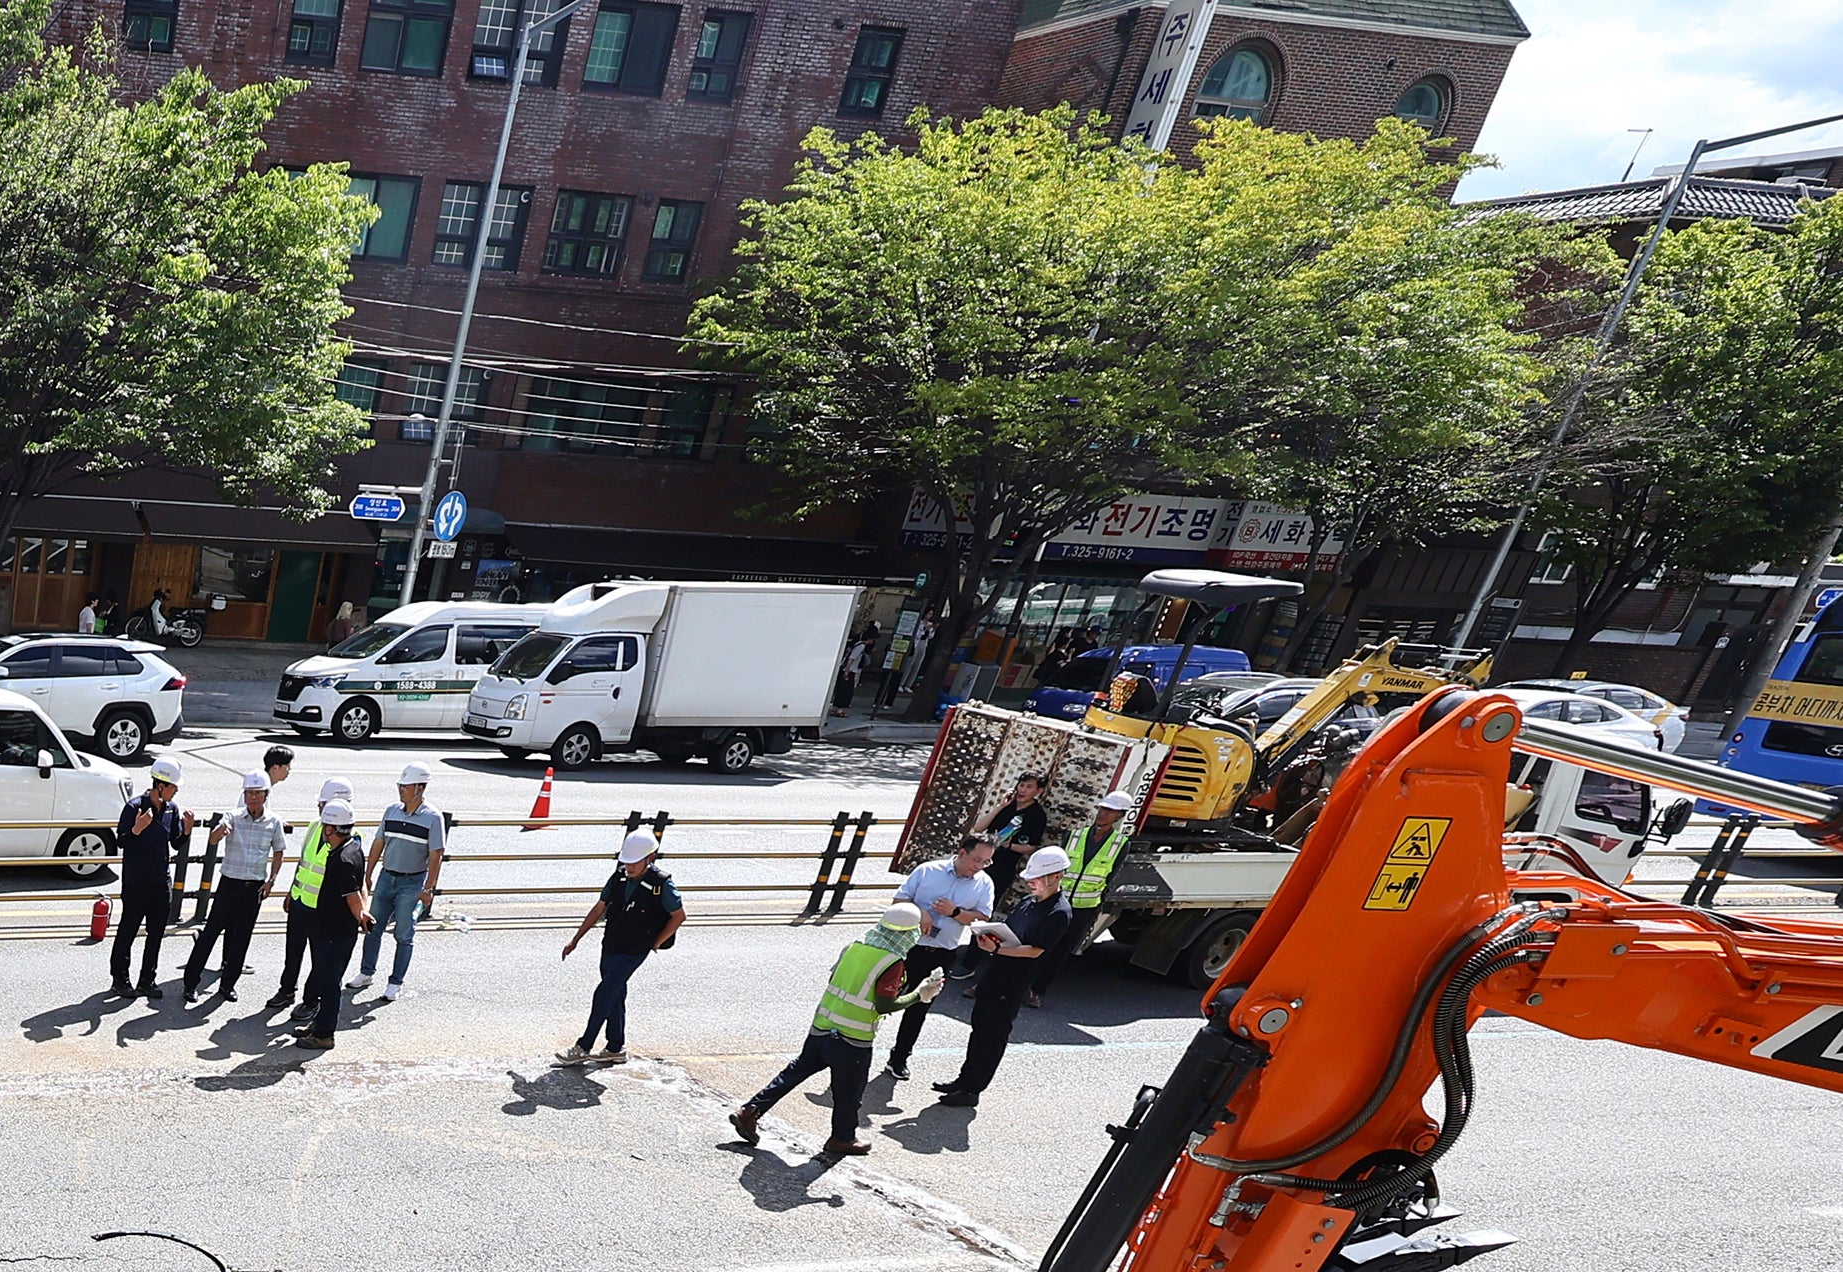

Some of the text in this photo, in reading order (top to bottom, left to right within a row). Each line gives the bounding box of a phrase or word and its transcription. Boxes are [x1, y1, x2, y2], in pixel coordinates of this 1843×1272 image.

[1061, 544, 1135, 561] T.325-9161~2
[1381, 676, 1426, 690] YANMAR
[1753, 693, 1796, 715] 콤부차
